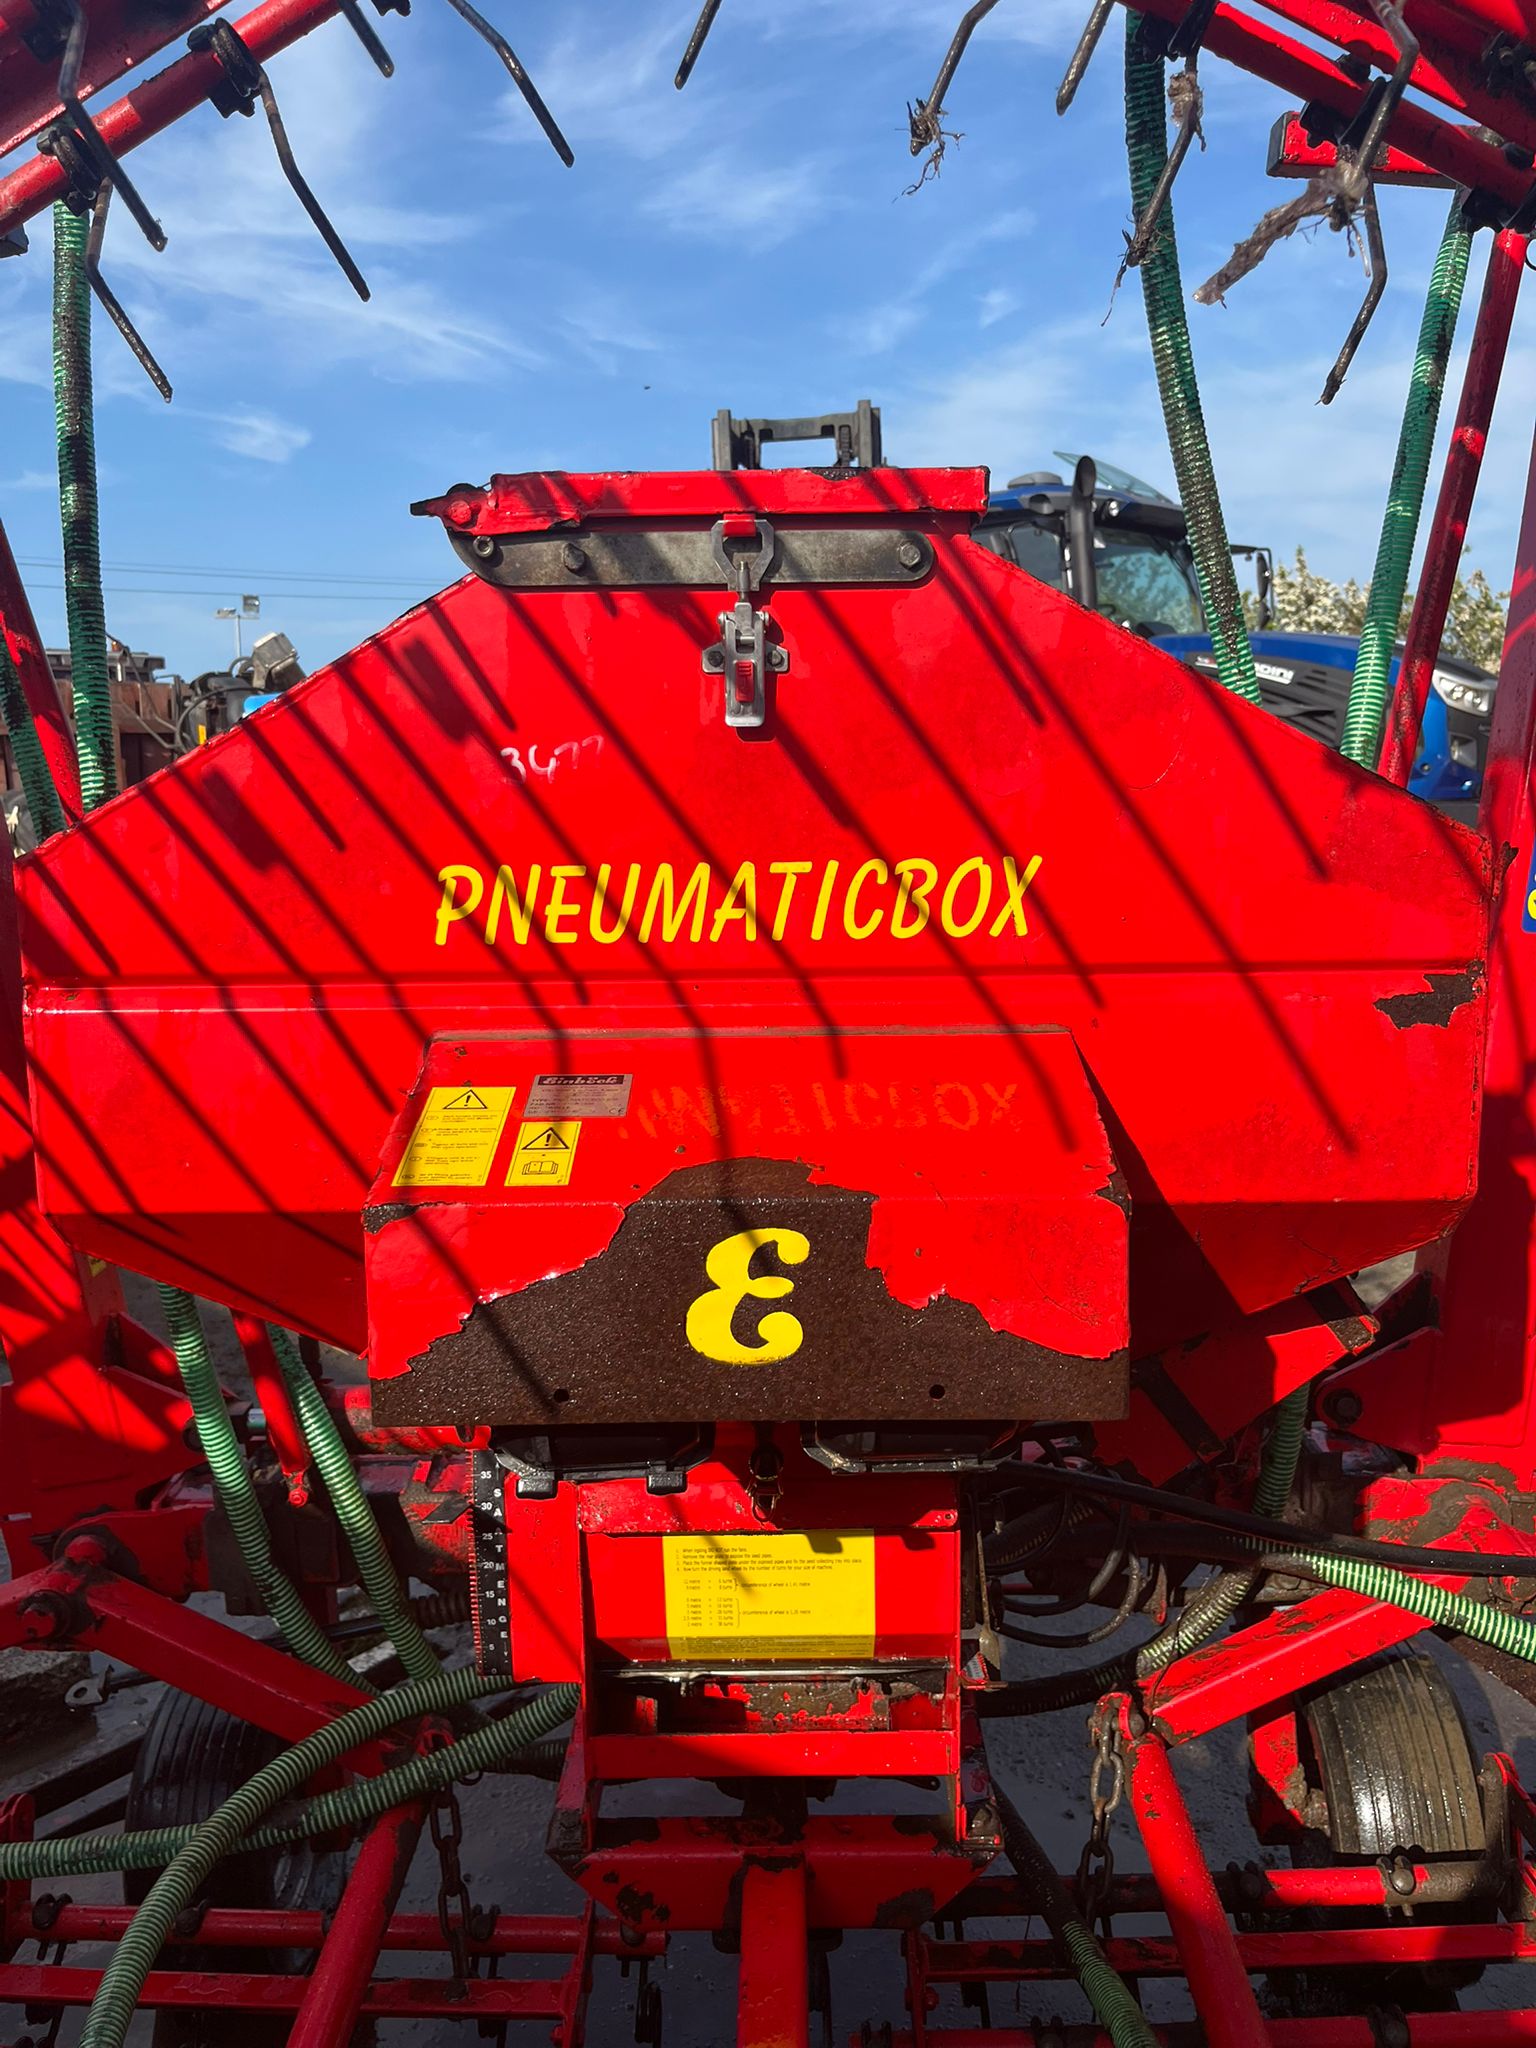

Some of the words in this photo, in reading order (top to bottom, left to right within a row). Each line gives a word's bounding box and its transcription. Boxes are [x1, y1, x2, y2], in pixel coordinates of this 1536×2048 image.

[434, 855, 1043, 946] PNEUMATICBOX
[480, 1470, 492, 1480] 35
[481, 1502, 493, 1511] 30
[482, 1533, 493, 1541] 25
[483, 1561, 495, 1569] 20
[485, 1590, 496, 1598] 15
[486, 1618, 497, 1626] 10
